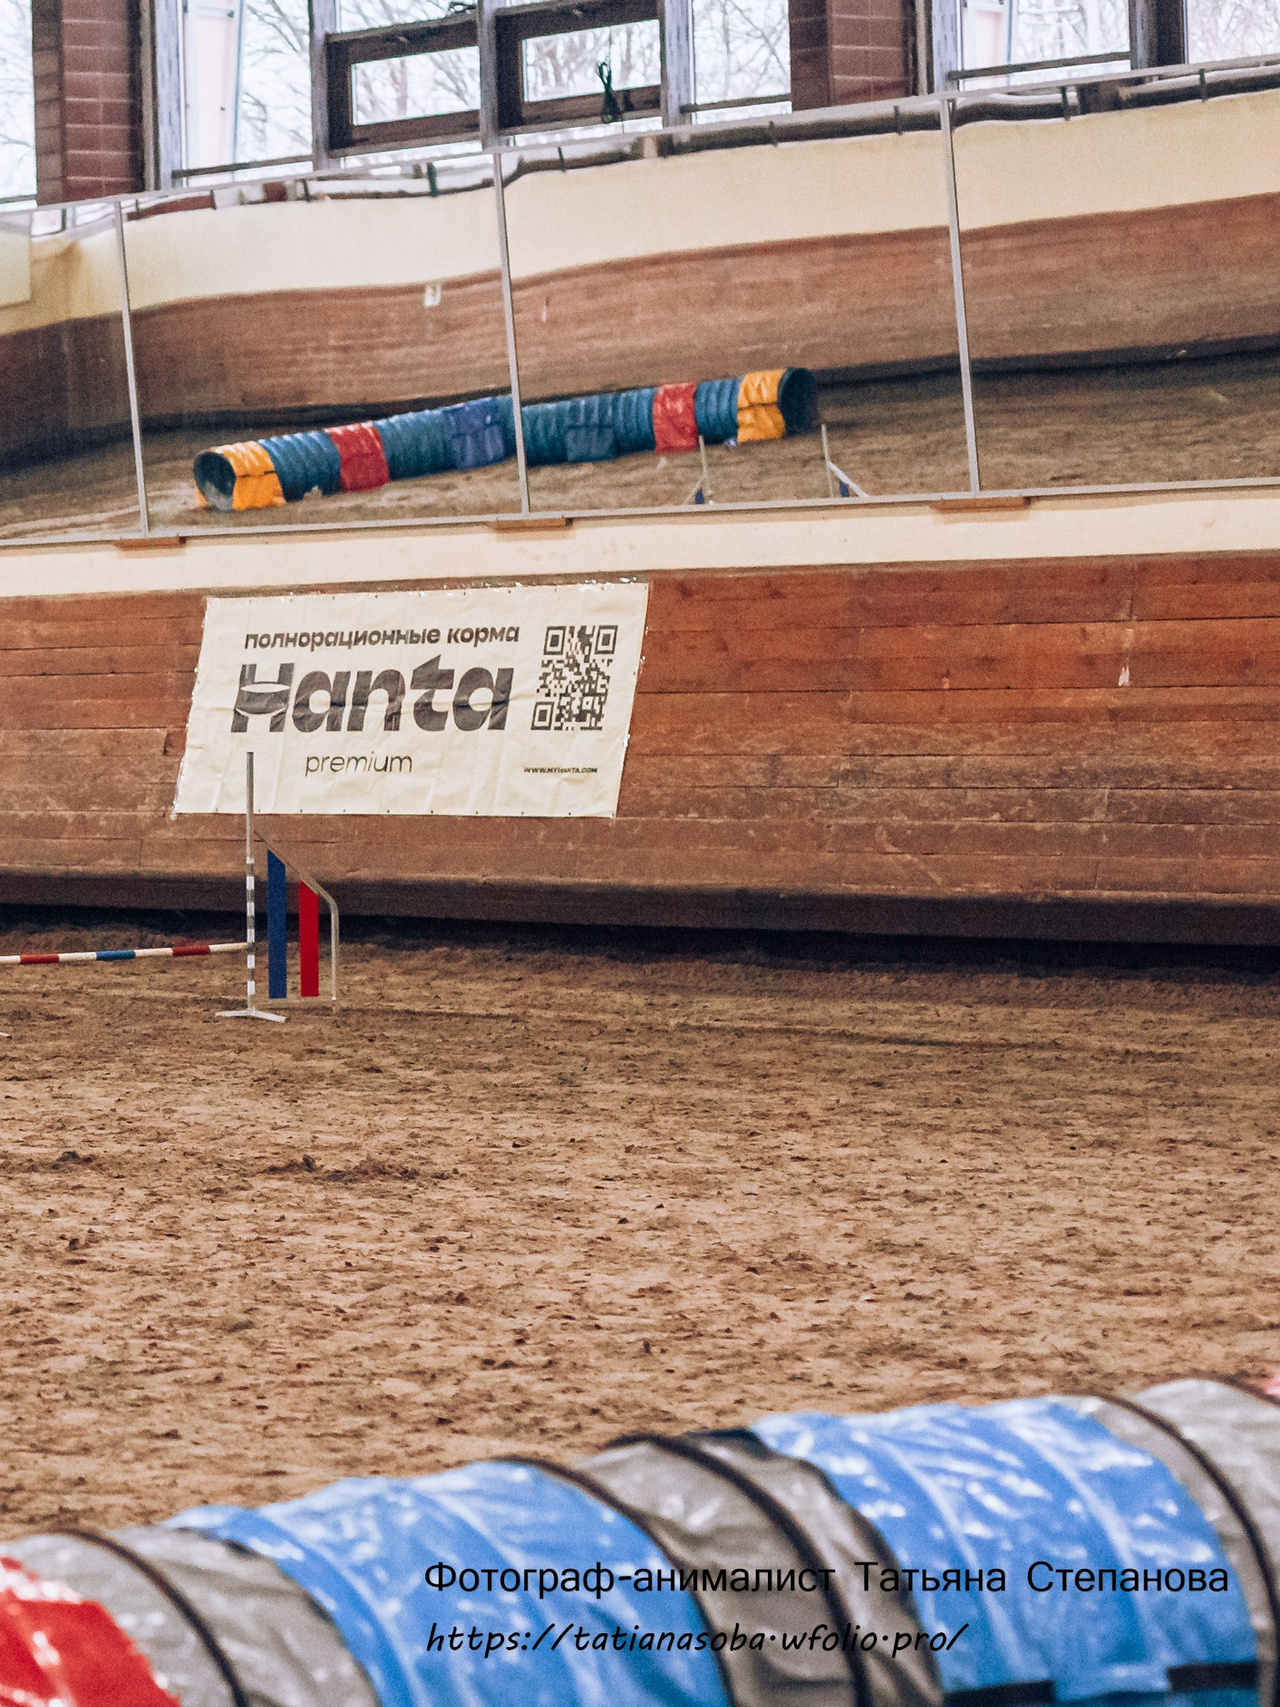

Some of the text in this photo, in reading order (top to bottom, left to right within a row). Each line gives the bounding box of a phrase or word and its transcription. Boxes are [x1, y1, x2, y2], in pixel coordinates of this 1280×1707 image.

[244, 625, 520, 652] полнорационные корма
[231, 654, 514, 733] Hanta
[305, 750, 413, 777] premium
